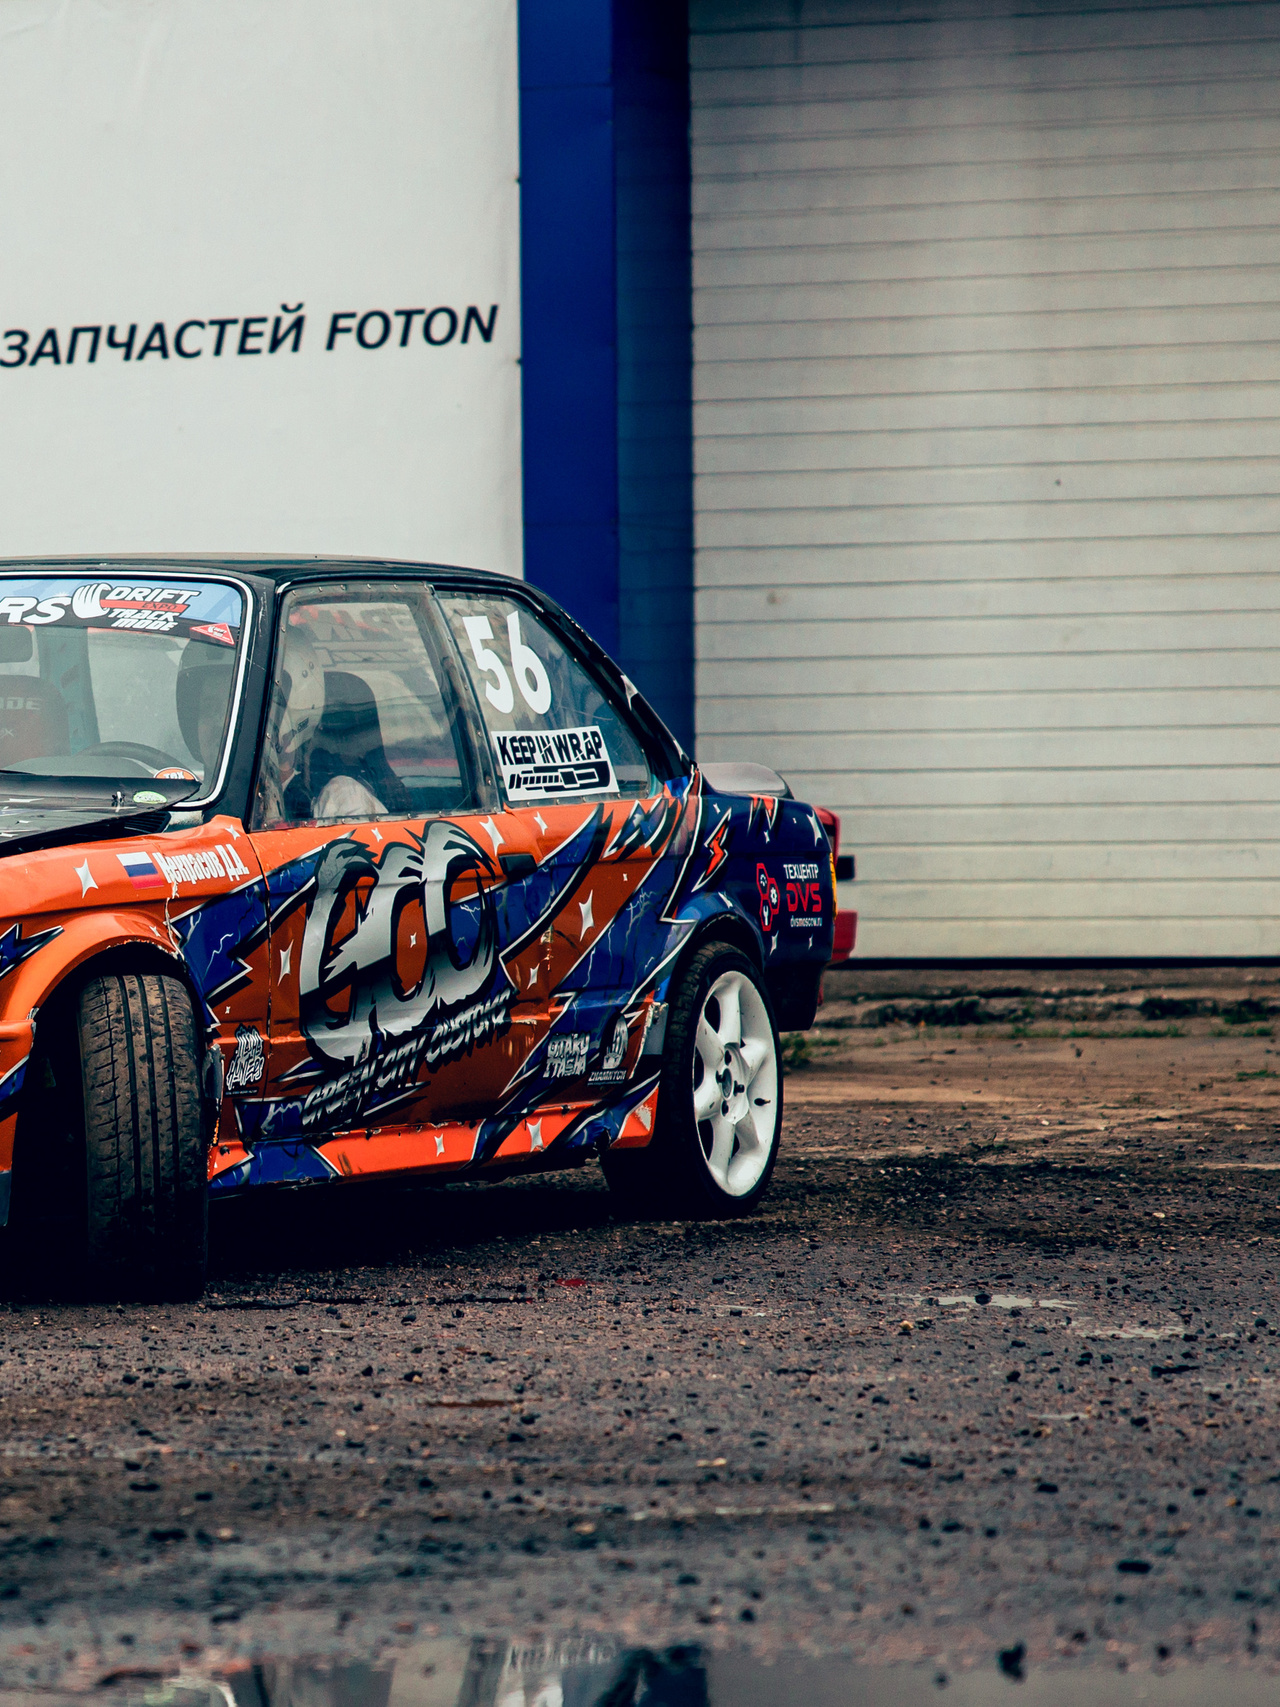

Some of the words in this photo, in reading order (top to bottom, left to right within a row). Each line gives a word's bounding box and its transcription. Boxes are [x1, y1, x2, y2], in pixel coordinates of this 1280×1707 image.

[324, 304, 499, 351] FOTON
[105, 587, 200, 604] DRIFT
[141, 602, 177, 611] EXPO
[462, 610, 552, 715] 56
[497, 735, 536, 766] KEEP
[783, 863, 819, 882] ТЕХЦЕНТР
[786, 882, 822, 912] DVS
